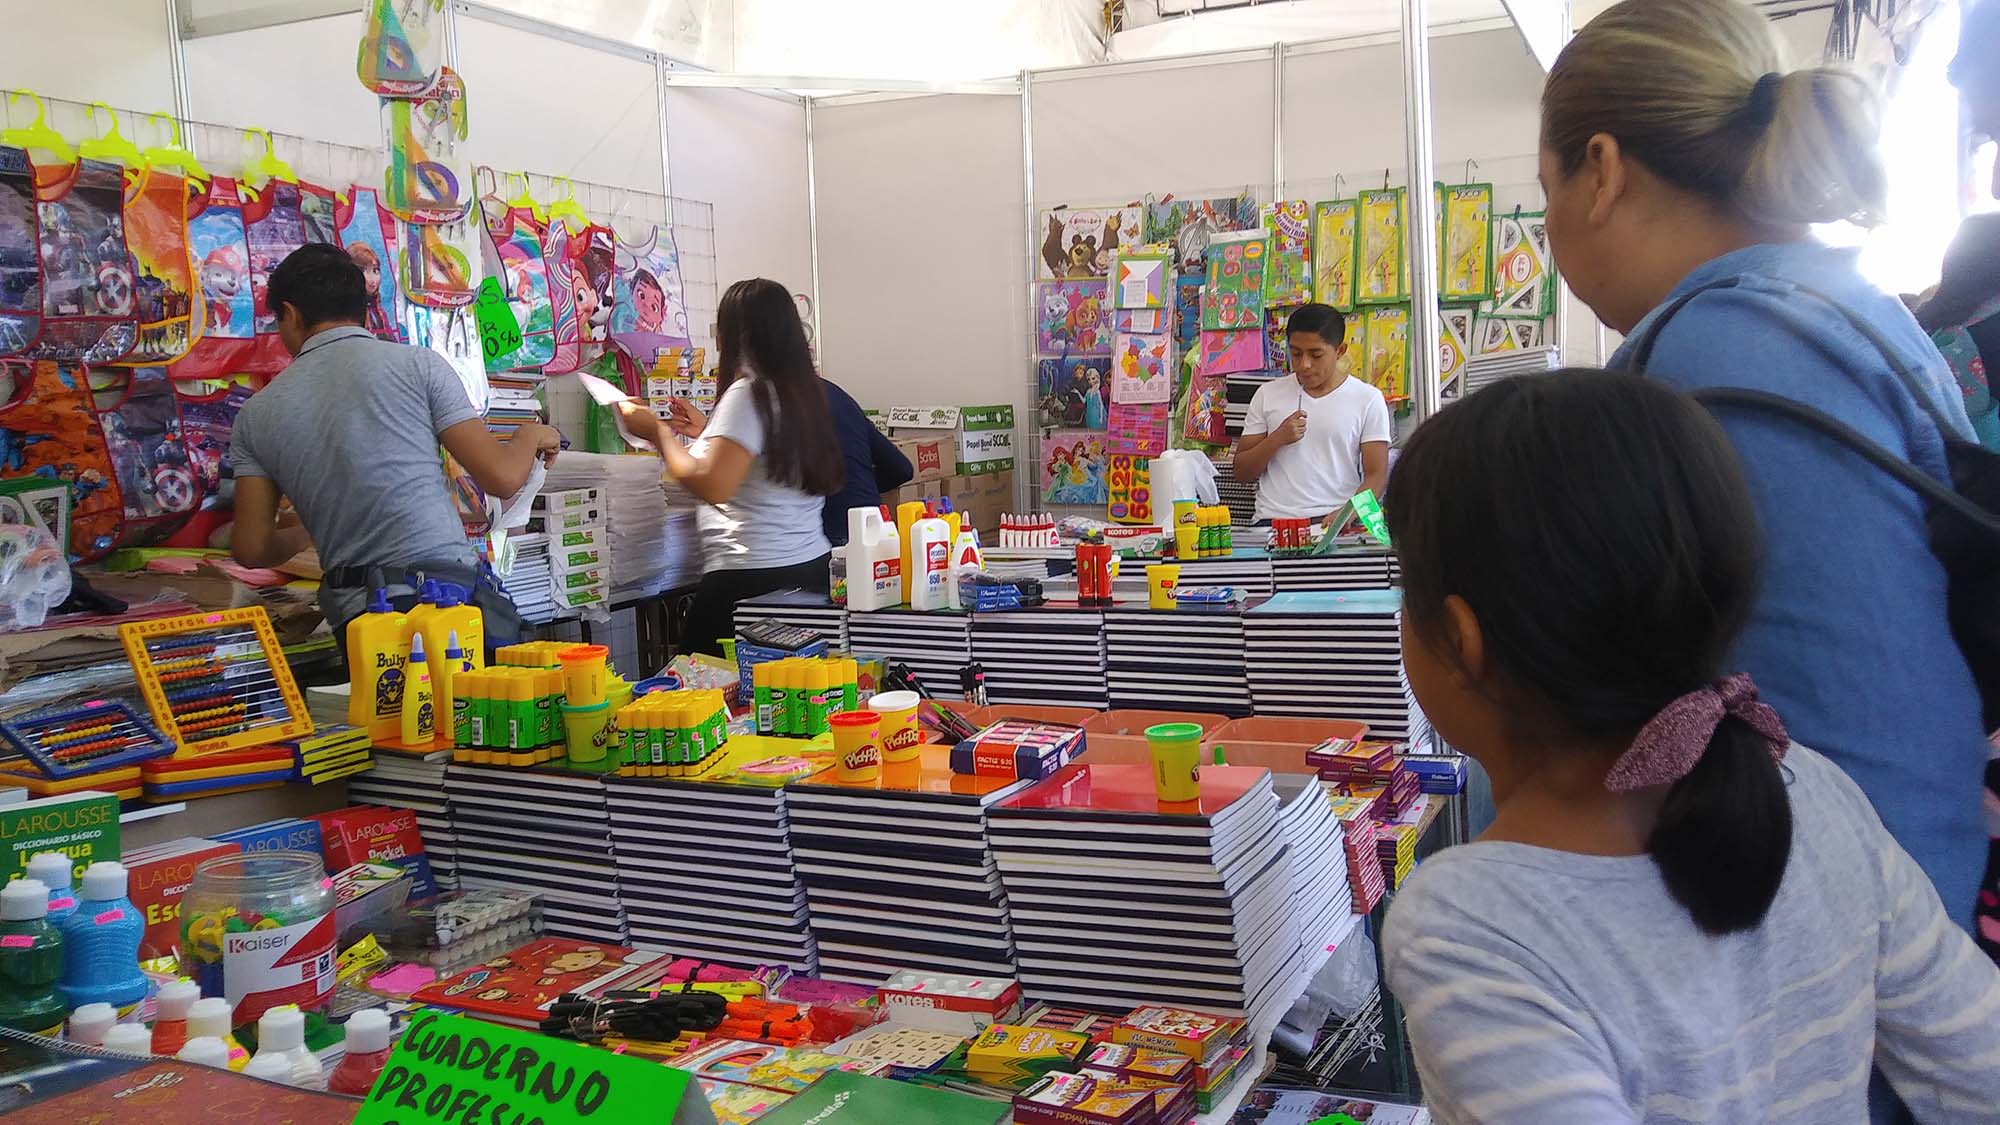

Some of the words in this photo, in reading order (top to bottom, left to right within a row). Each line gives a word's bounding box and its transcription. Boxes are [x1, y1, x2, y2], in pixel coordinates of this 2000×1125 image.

[376, 653, 407, 668] Bully
[1, 804, 112, 839] LAROUSSE
[13, 834, 70, 851] DICCIONARIO
[71, 829, 102, 842] BÁSICO
[246, 828, 318, 853] AROUSSE
[368, 843, 406, 860] Pocket
[138, 861, 196, 890] LARO
[229, 934, 291, 953] Kaiser
[884, 993, 934, 1008] Kores
[1147, 1037, 1177, 1048] MEMORY
[403, 1015, 611, 1117] CUADERNO
